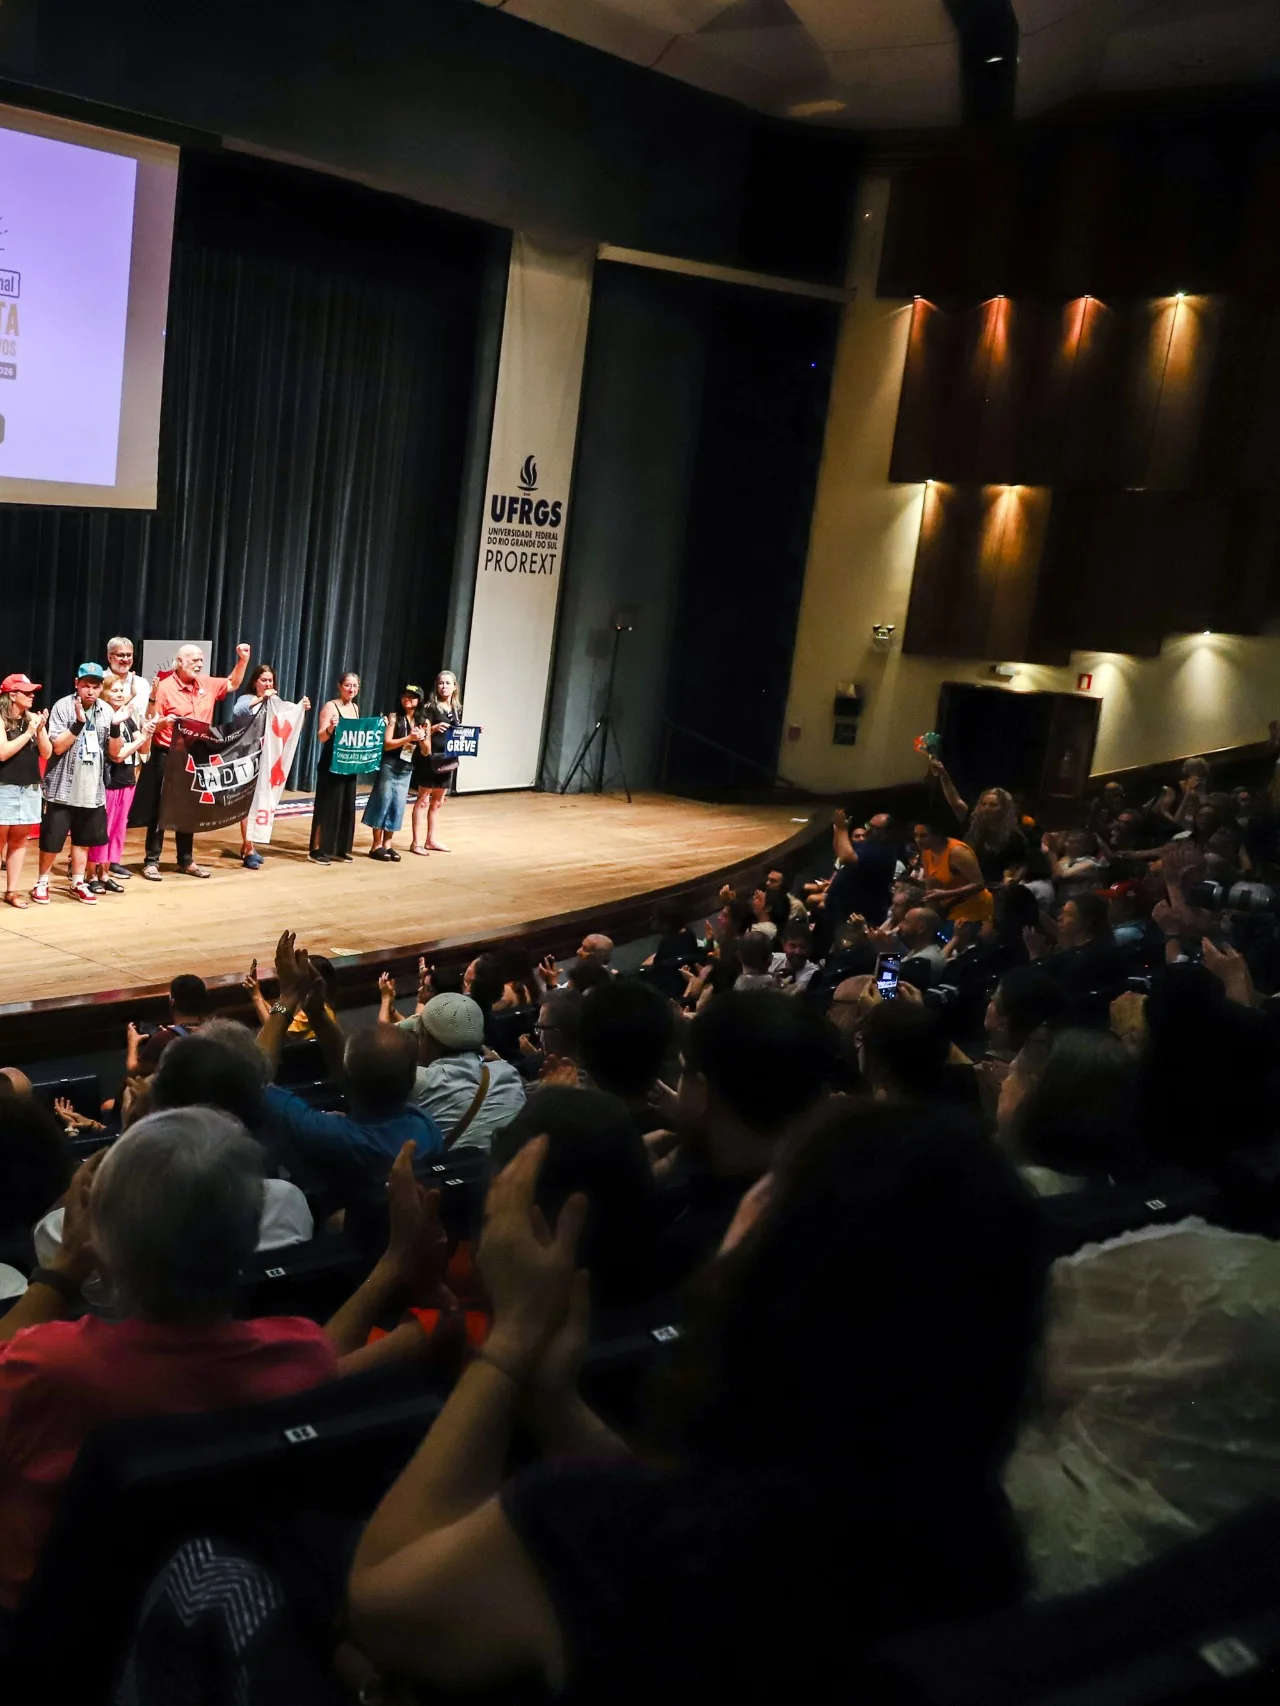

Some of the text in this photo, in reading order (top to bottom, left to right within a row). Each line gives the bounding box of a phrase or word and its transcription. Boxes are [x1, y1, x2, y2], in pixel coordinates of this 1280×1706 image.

[490, 494, 562, 528] UFRGS
[488, 527, 558, 540] UNIVERSIDADE FEDERAL
[487, 536, 557, 550] DO RIO GRANDE DO SUL
[484, 549, 556, 575] PROREXT
[338, 730, 383, 747] ANDES
[446, 740, 477, 752] GREVE
